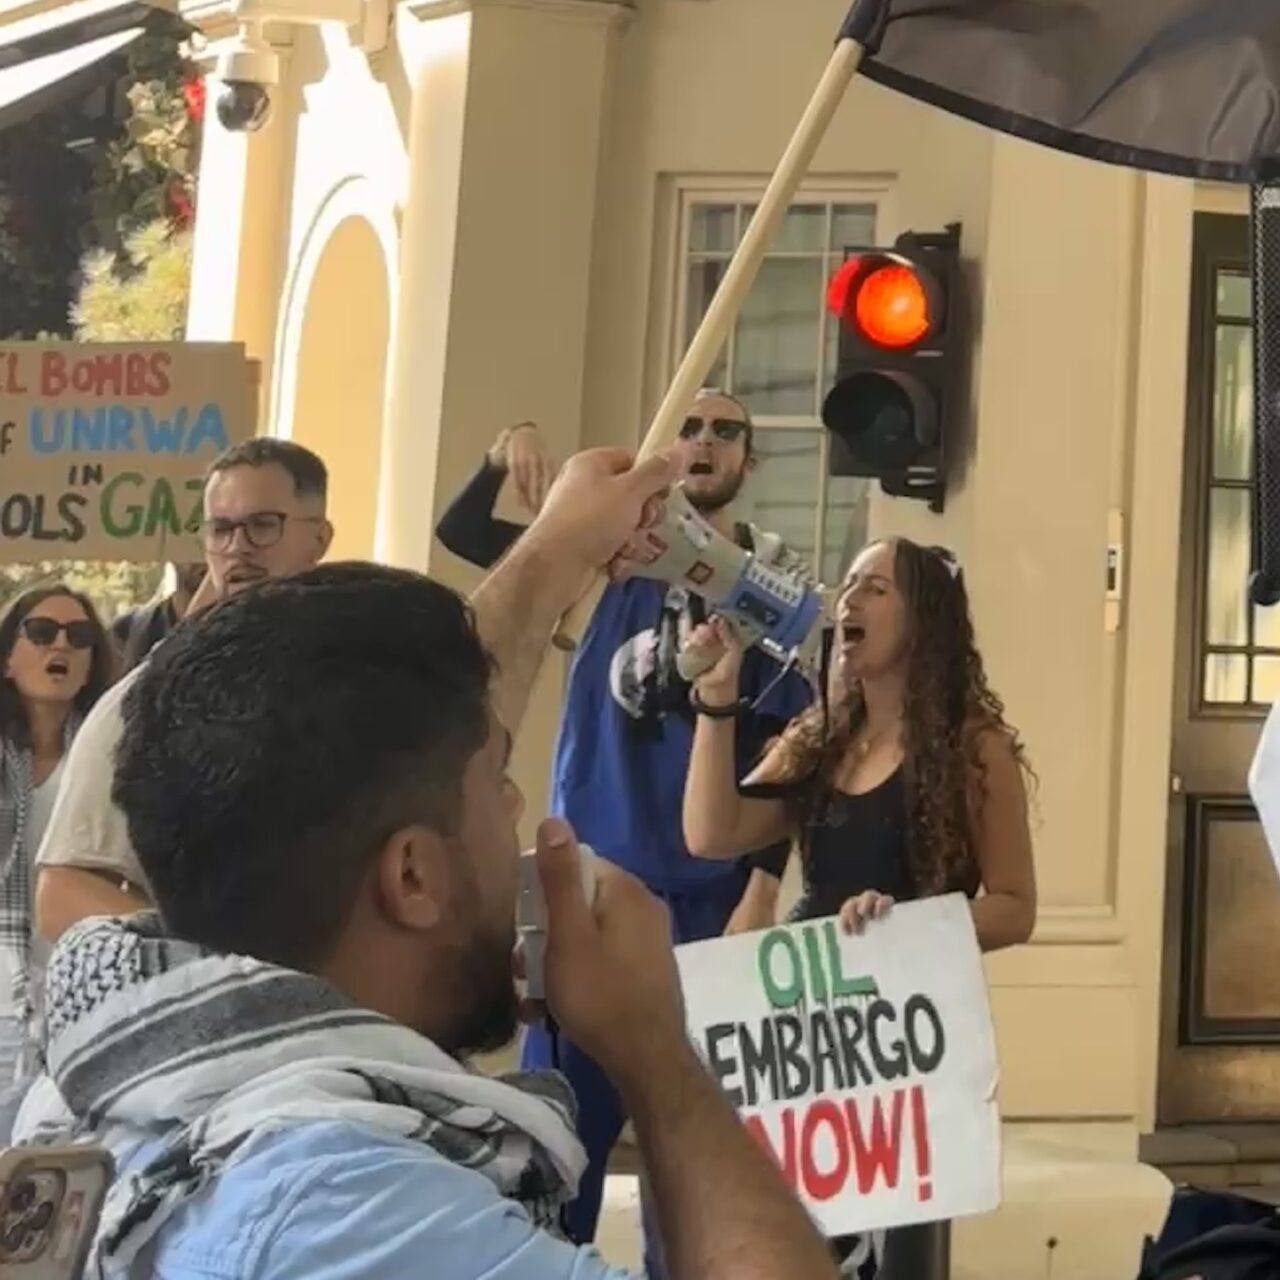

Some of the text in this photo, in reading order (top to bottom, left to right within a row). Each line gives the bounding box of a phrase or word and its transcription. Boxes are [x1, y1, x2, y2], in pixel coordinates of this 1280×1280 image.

[0, 352, 27, 394] L
[27, 403, 228, 453] UNRWA
[68, 464, 103, 485] IN
[757, 920, 878, 1009] OIL
[705, 993, 945, 1107] EMBARGO
[743, 1084, 932, 1202] NOW!
